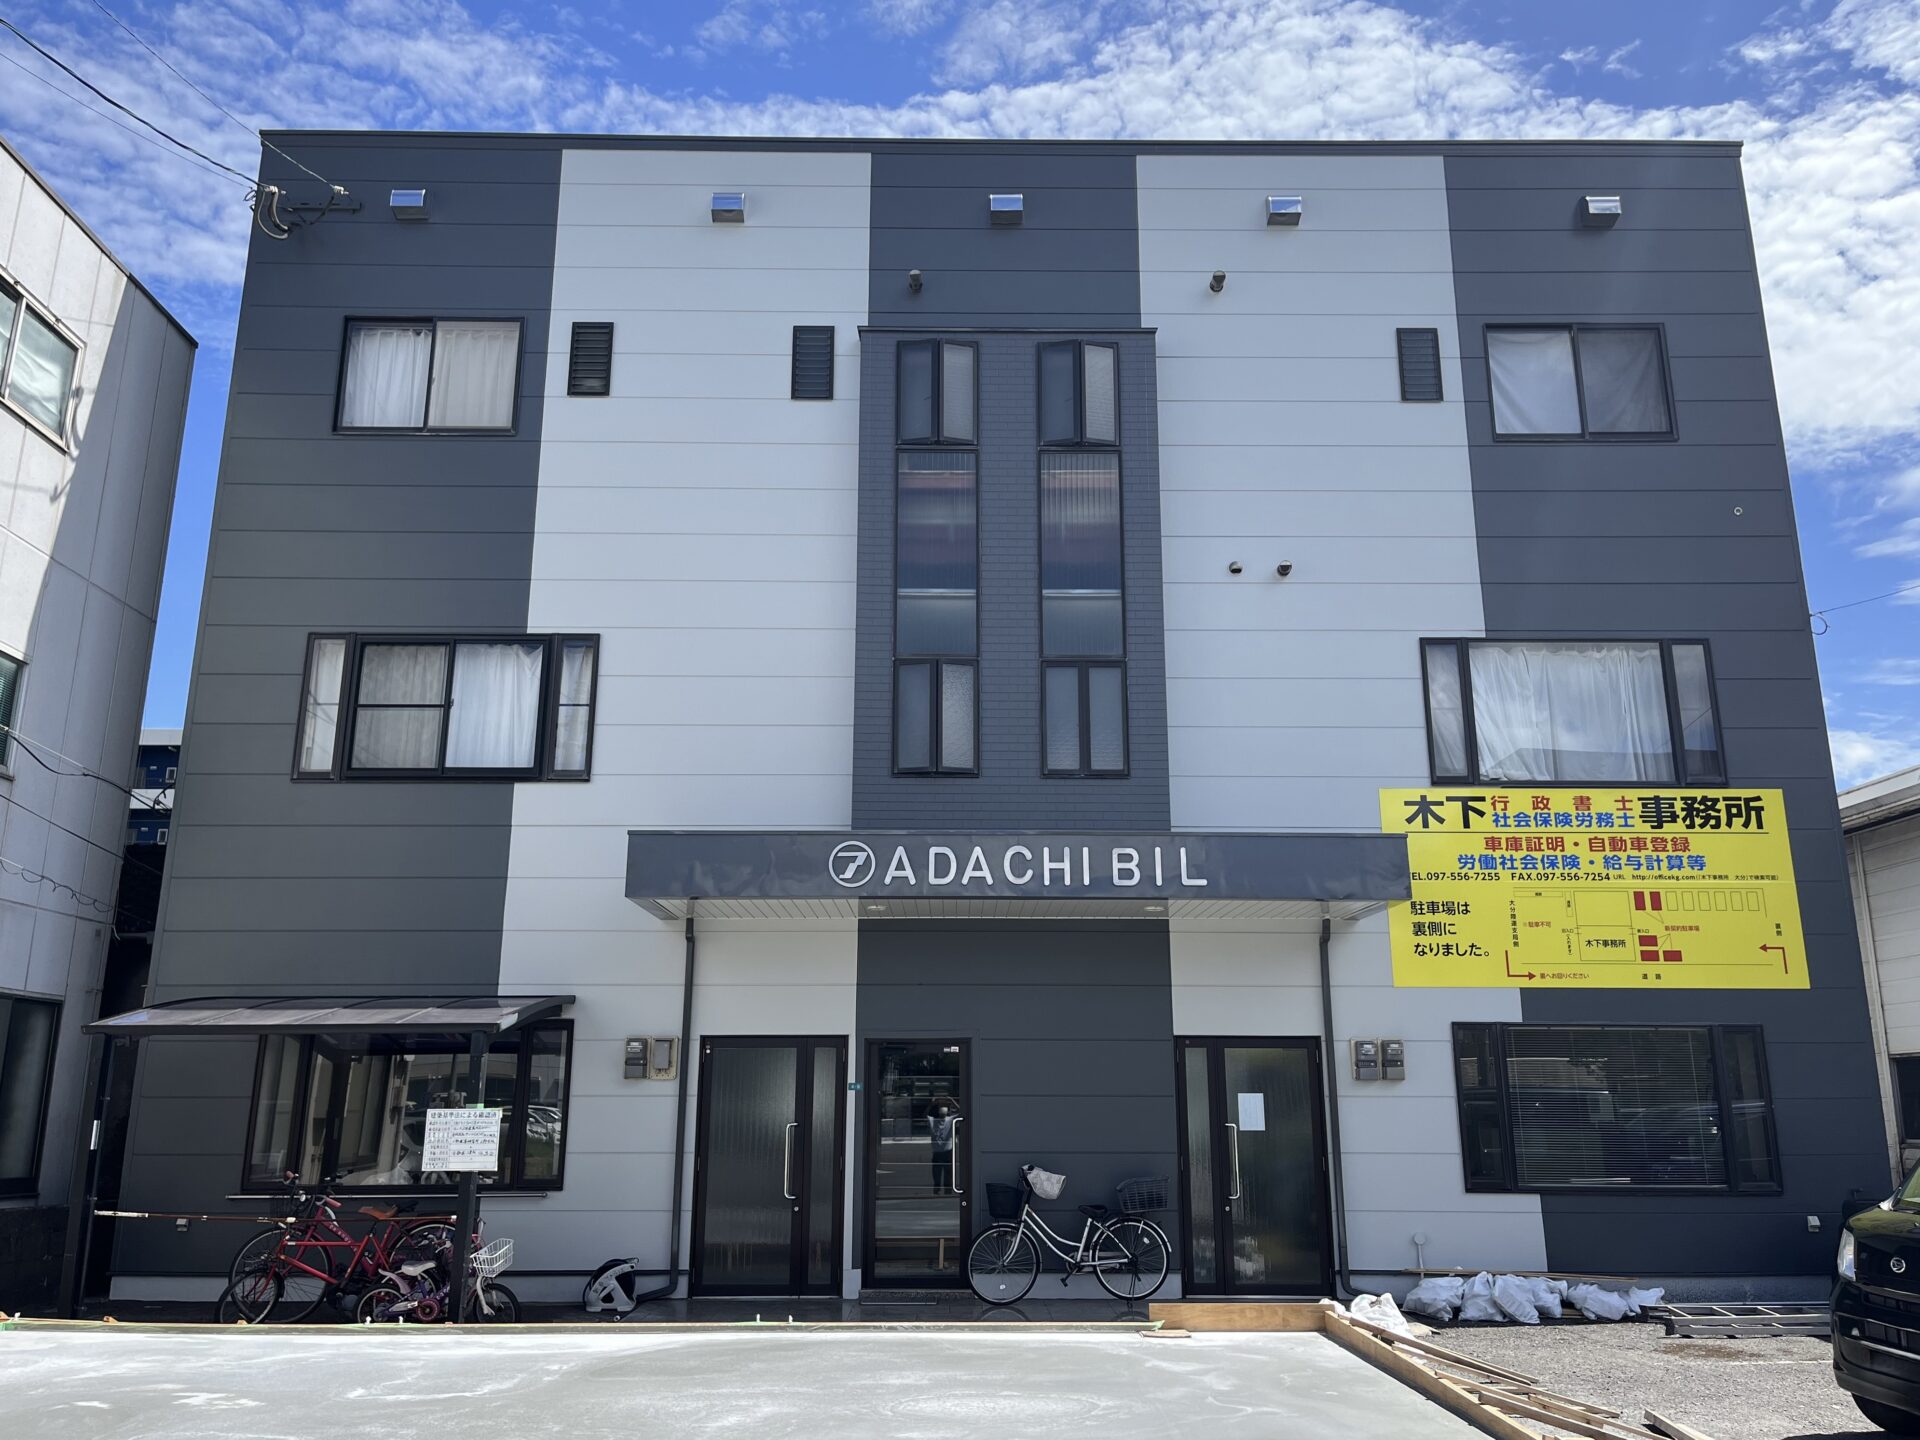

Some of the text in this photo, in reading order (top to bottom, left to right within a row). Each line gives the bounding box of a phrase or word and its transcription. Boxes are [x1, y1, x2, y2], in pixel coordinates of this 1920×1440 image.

[1491, 795, 1633, 811] 行政書士
[1404, 795, 1486, 829] 木下
[1492, 812, 1635, 828] 社会保険労務士
[1637, 795, 1765, 830] 事務所
[1484, 836, 1691, 853] 車庫証明・自動車登録
[884, 845, 1208, 887] ADACHI BIL
[1458, 854, 1707, 871] 労働社会保険・給与計算等
[1511, 872, 1611, 881] FAX.097-556-7254
[1410, 901, 1471, 916] 駐車場は
[1412, 921, 1457, 937] 裏側に
[1413, 942, 1490, 957] なりました。
[1585, 939, 1626, 948] 木下事務所
